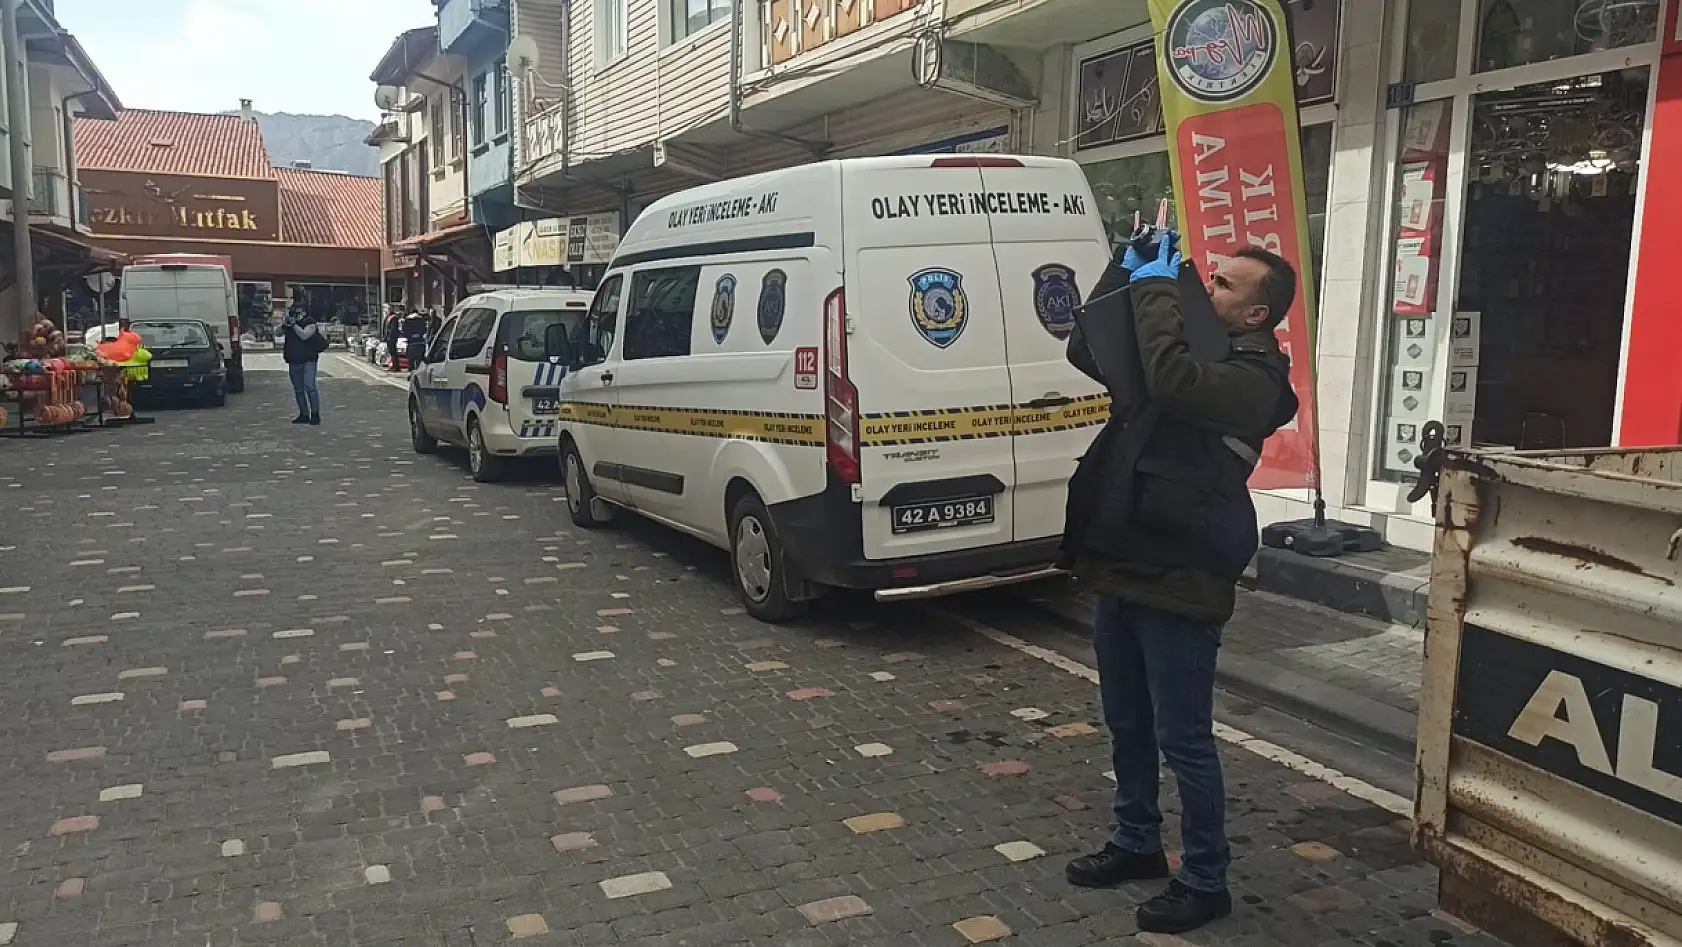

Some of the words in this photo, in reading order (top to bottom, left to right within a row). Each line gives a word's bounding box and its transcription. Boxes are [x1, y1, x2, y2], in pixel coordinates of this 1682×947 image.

[872, 195, 920, 219] OLAY
[798, 352, 815, 371] 112
[537, 399, 551, 409] 42
[866, 424, 890, 435] OLAY
[972, 417, 992, 427] OLAY
[901, 508, 924, 524] 42
[928, 507, 940, 522] A
[944, 500, 986, 520] 9384
